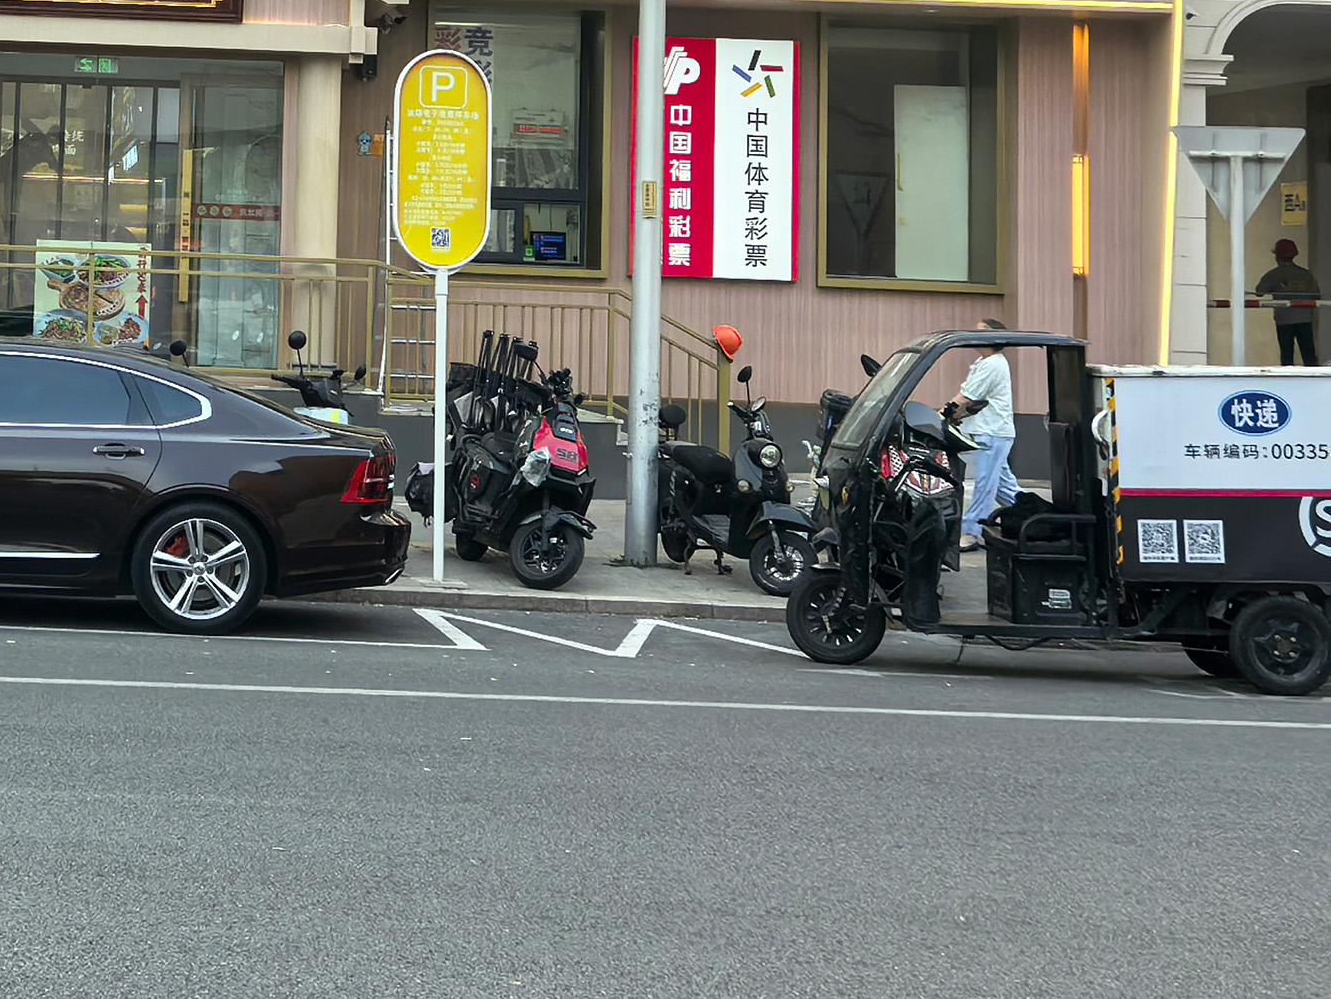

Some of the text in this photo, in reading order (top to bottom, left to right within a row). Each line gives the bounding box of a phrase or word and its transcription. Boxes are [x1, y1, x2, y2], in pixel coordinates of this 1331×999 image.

[432, 72, 455, 102] P
[668, 103, 693, 267] 中国福利彩票
[744, 107, 769, 268] 中国体育彩票
[1230, 399, 1280, 428] 快递
